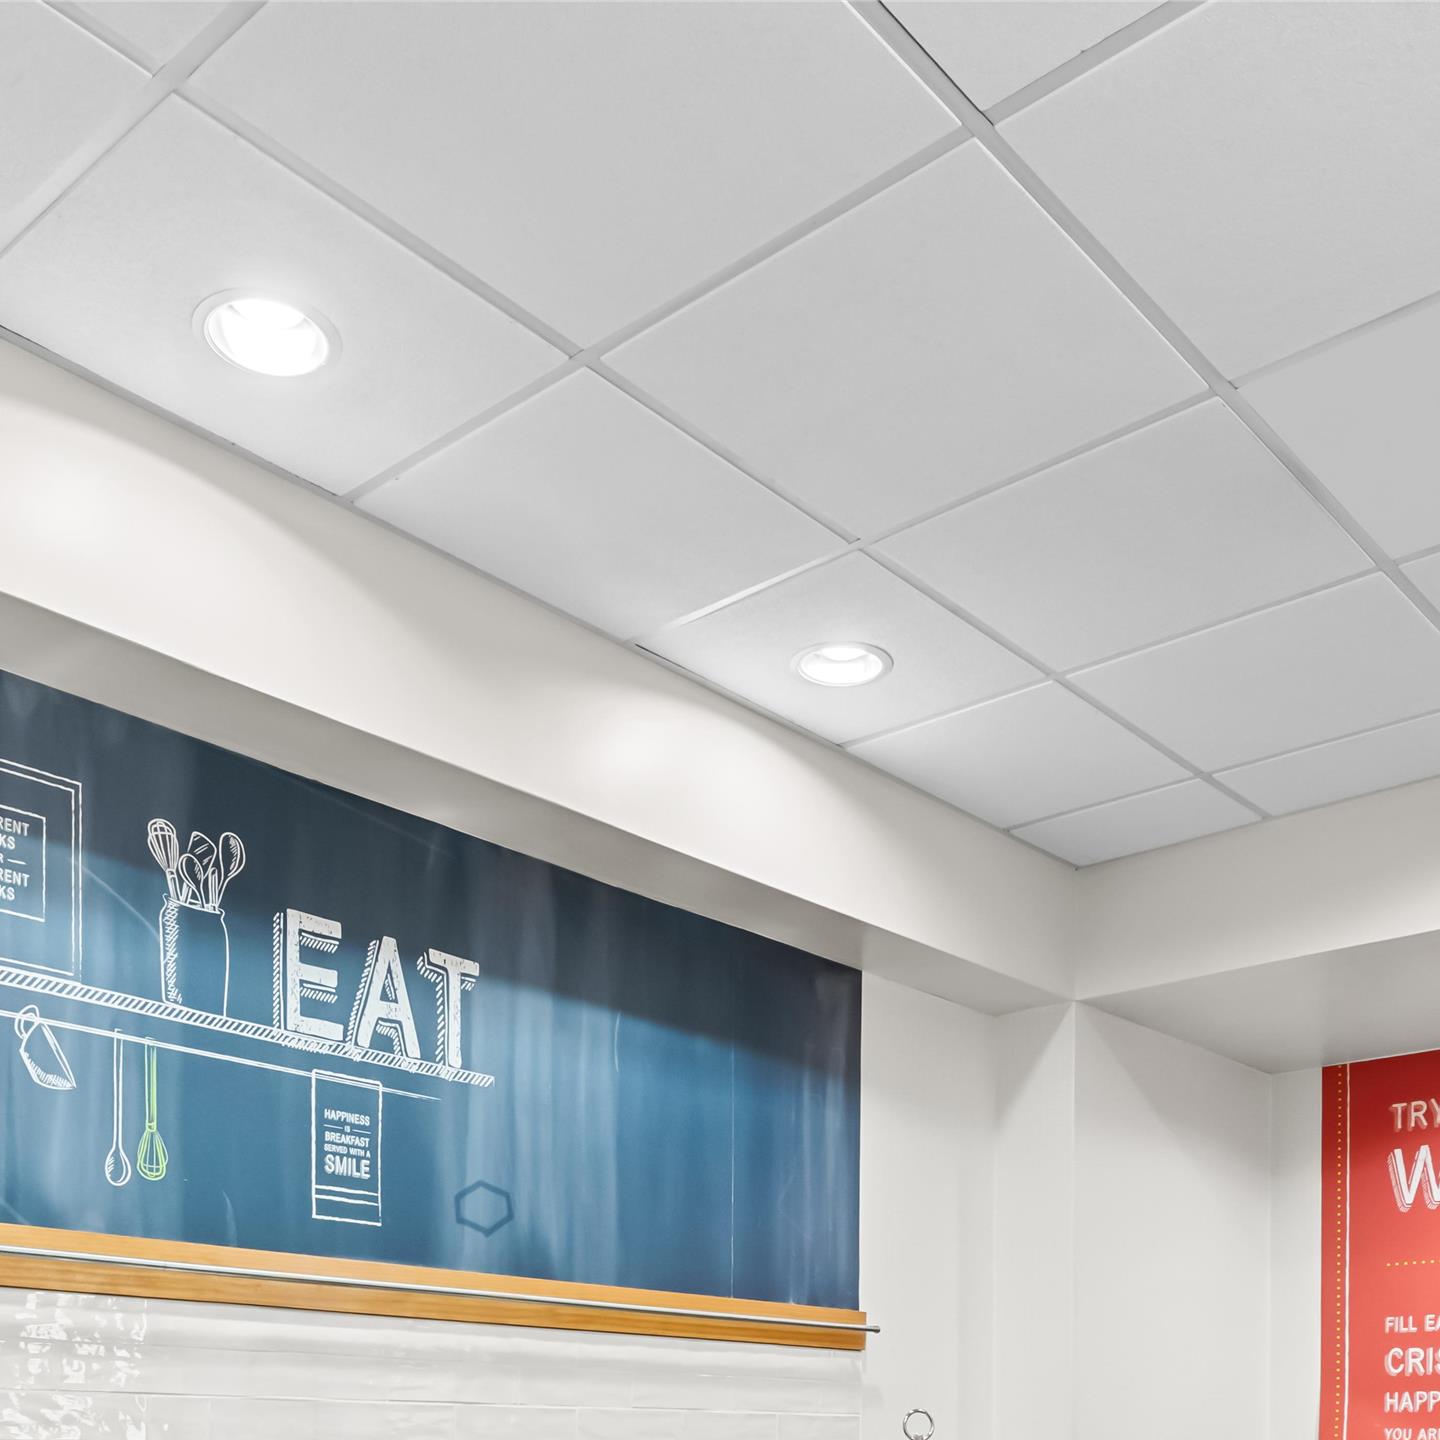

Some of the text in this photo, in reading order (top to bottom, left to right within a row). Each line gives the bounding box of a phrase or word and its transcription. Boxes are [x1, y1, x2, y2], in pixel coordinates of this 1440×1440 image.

[273, 908, 480, 1069] EAT
[324, 1108, 370, 1126] HAPPINESS
[324, 1131, 370, 1148] BREAKFAST
[324, 1143, 371, 1158] SERVED WITH A
[324, 1154, 371, 1179] SMILE
[1385, 1316, 1417, 1333] FILL
